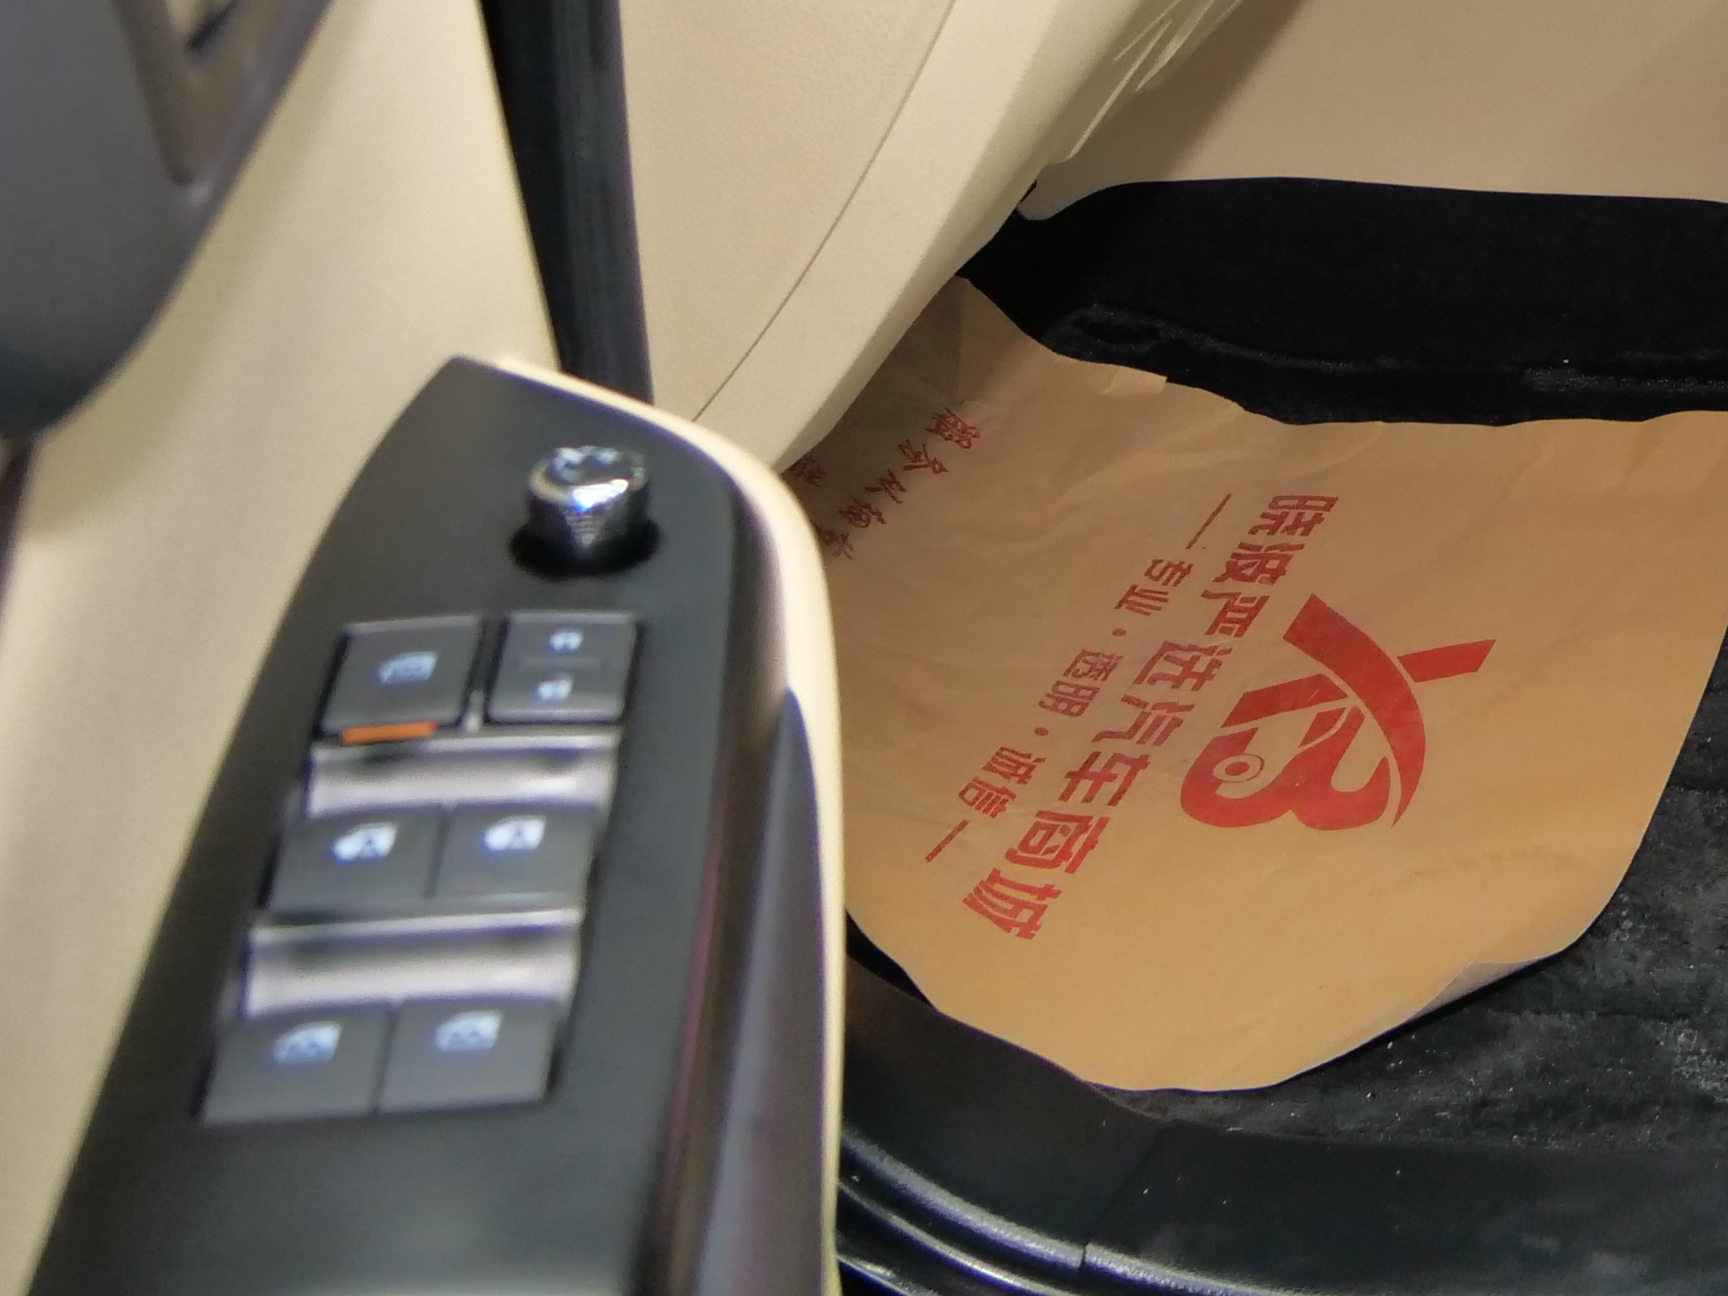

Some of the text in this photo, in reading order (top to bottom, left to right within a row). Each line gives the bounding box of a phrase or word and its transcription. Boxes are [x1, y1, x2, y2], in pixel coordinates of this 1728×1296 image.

[962, 493, 1339, 939] 晓波严选汽车商城
